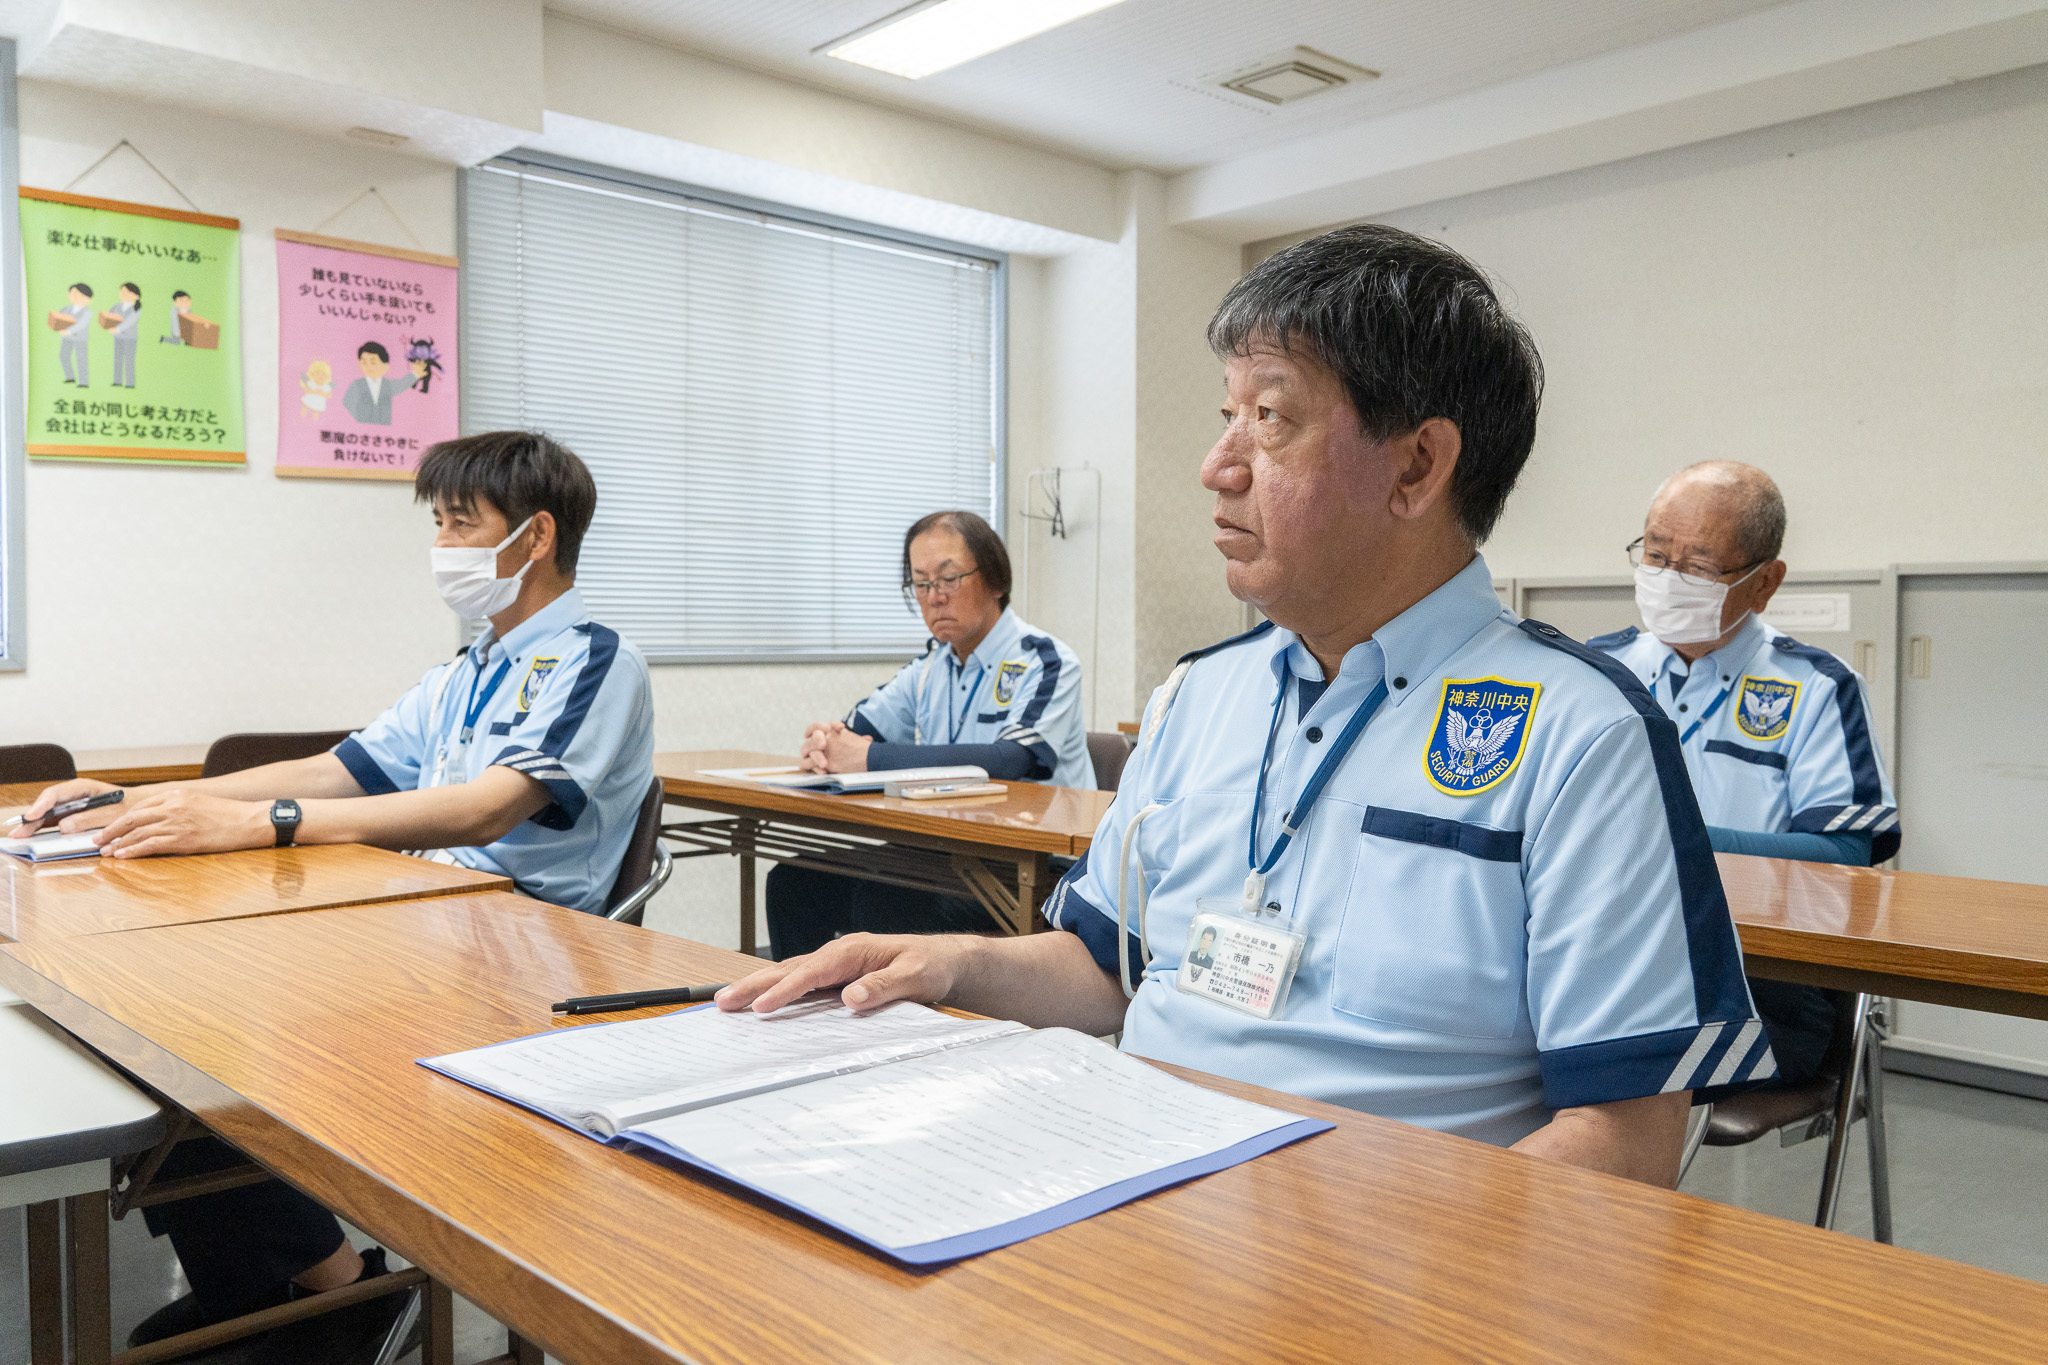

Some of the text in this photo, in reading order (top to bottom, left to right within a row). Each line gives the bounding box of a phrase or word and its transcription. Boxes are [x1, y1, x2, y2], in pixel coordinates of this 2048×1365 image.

[312, 267, 424, 296] 誰も見ていないなら
[298, 283, 436, 314] 少しくらい手を抜いても
[54, 398, 219, 425] 全員が同じ考え方だと
[45, 417, 226, 444] 会社はどうなるだろう？
[320, 429, 419, 450] 悪魔のささやきに
[1448, 688, 1529, 712] 神奈川中央
[1430, 750, 1509, 787] SECURITY GUARD
